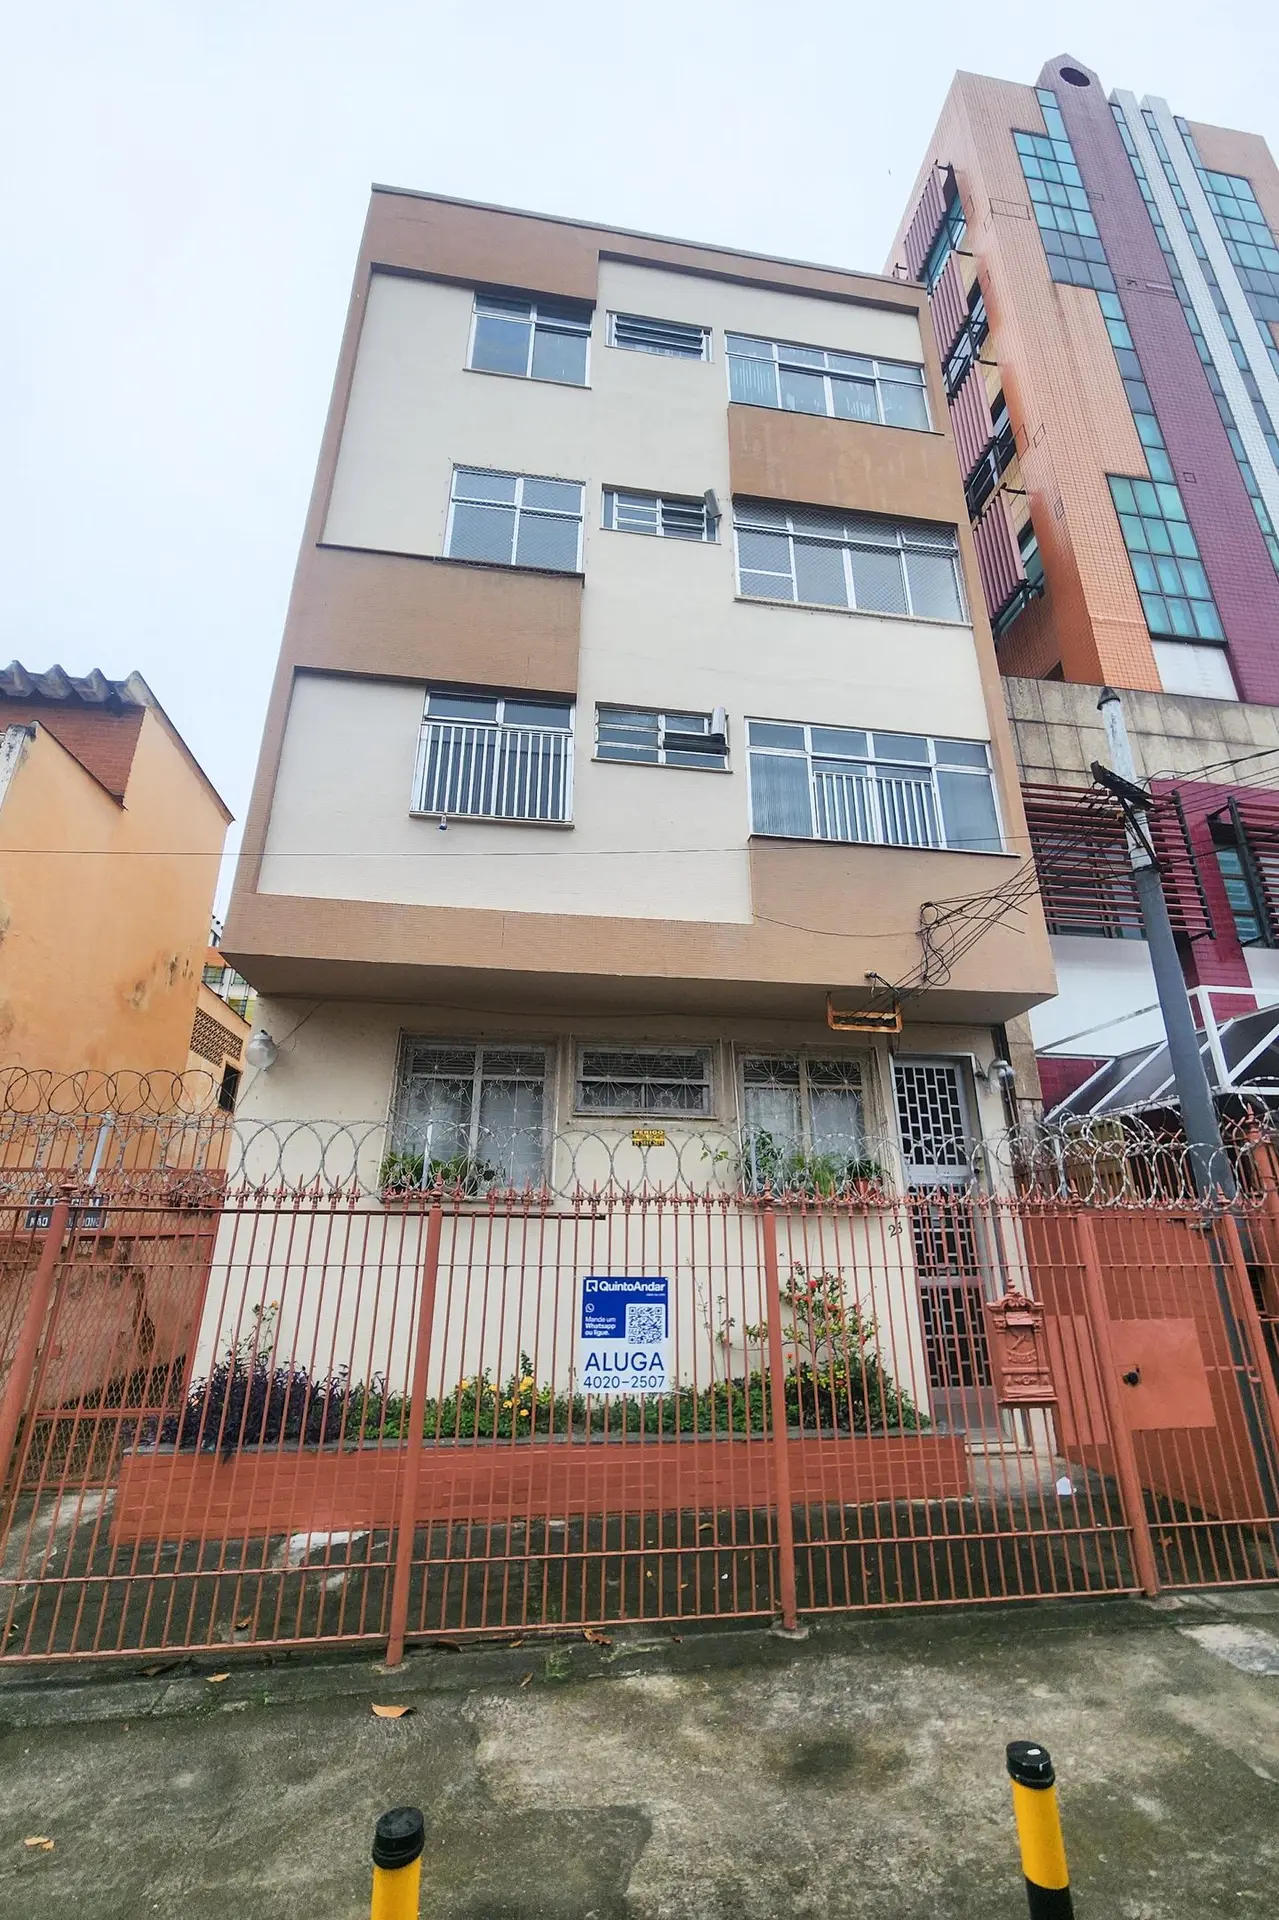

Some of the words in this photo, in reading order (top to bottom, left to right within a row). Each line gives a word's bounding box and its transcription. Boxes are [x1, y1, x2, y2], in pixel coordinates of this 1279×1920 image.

[599, 1281, 666, 1292] QuintoAndar
[584, 1352, 664, 1371] ALUGA
[583, 1375, 665, 1389] 4020-2507
